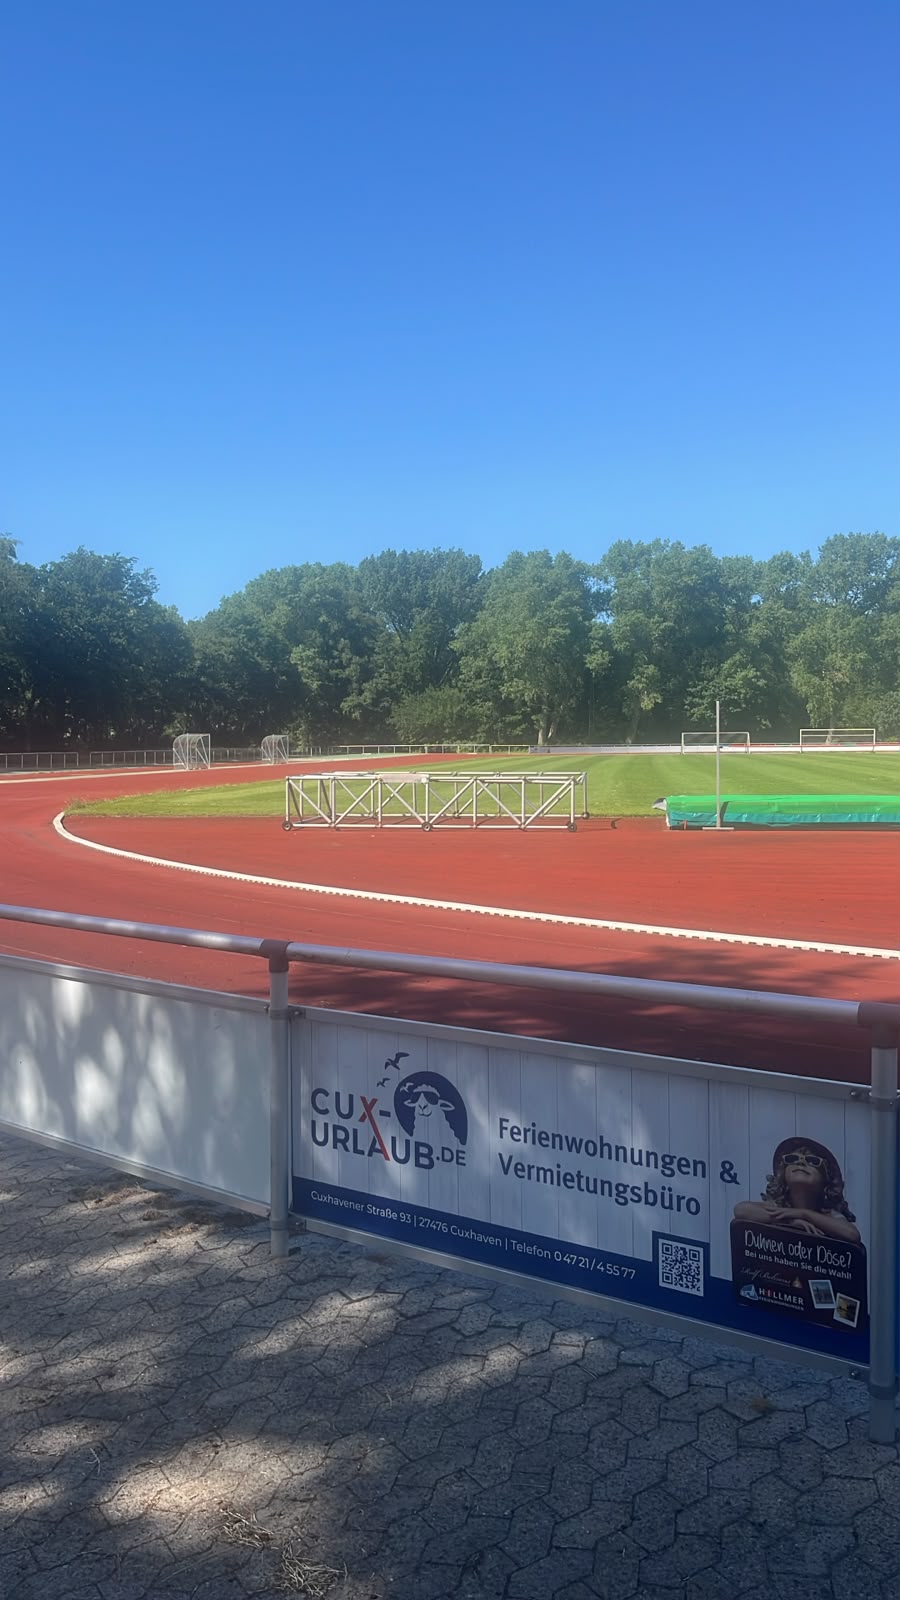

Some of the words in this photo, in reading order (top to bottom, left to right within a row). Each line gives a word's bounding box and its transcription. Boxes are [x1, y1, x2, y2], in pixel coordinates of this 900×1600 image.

[311, 1087, 392, 1123] CUX-
[311, 1119, 466, 1170] URLAUB.DE
[499, 1117, 707, 1178] Ferienwohnungen
[719, 1160, 741, 1185] &
[498, 1152, 701, 1216] Vermietungsbüro
[310, 1190, 364, 1212] Cuxhavener
[366, 1204, 398, 1221] Straße
[399, 1212, 412, 1224] 93
[418, 1216, 449, 1233] 27476
[450, 1225, 502, 1248] Cuxhaven
[510, 1239, 551, 1260] Telefon
[744, 1229, 786, 1256] Duhnen
[788, 1241, 813, 1261] oder
[816, 1245, 852, 1269] Döse?
[744, 1249, 757, 1259] Bei
[758, 1253, 773, 1263] uns
[774, 1256, 799, 1269] haben
[800, 1261, 813, 1272] Sie
[814, 1265, 828, 1276] die
[828, 1268, 852, 1280] Wahl!
[758, 1287, 805, 1306] HILLMER
